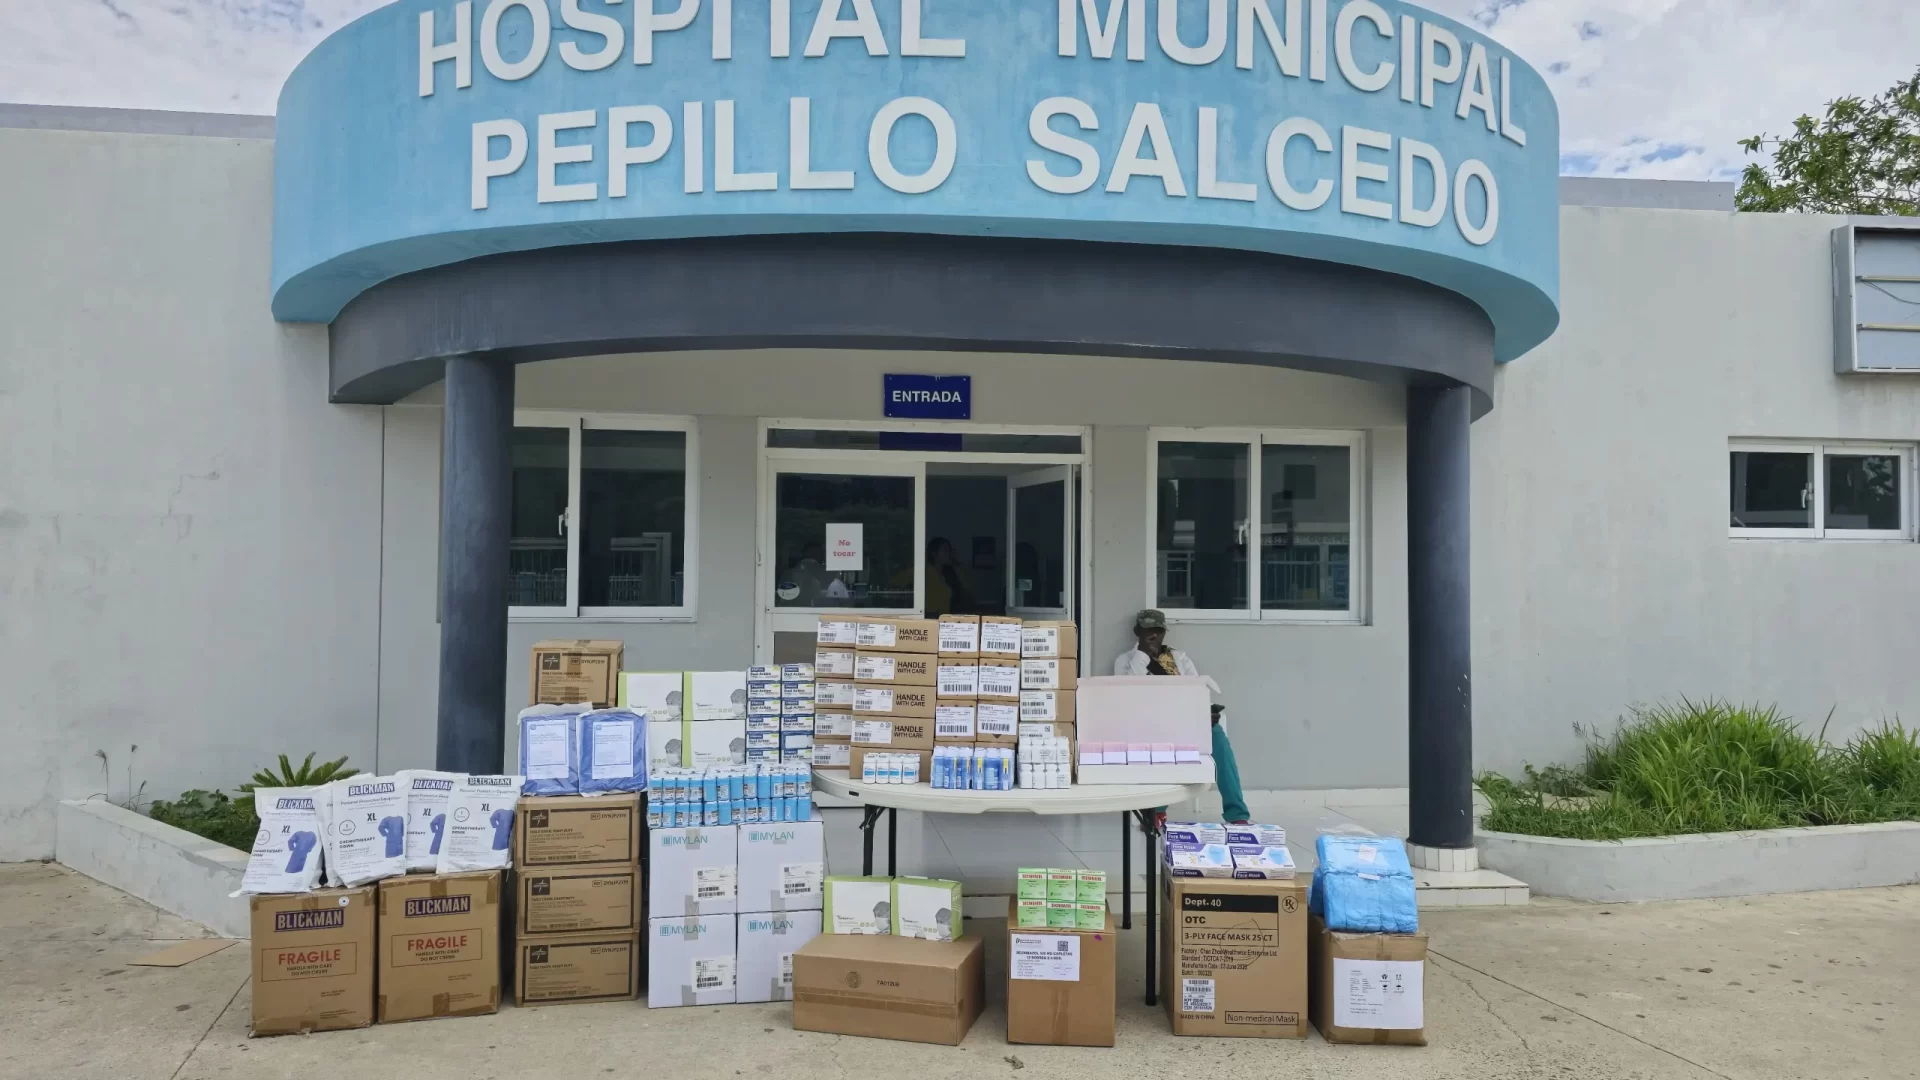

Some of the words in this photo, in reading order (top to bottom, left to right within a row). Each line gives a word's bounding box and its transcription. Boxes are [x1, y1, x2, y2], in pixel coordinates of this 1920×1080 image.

[1058, 0, 1526, 146] MUNICIPAL
[471, 96, 957, 210] PEPILLO
[1026, 96, 1499, 246] SALCEDO
[892, 391, 961, 402] ENTRADA
[895, 725, 924, 733] HANDLE
[350, 783, 394, 795] BLICKMAN
[423, 808, 432, 816] XL
[367, 813, 377, 821] XL
[282, 825, 291, 833] XL
[673, 836, 708, 845] MYLAN
[759, 832, 794, 840] MYLAN
[408, 898, 468, 915] BLICKMAN
[1185, 898, 1209, 906] Dept.
[1211, 899, 1222, 907] 40
[278, 911, 342, 929] BLICKMAN
[1185, 916, 1206, 924] OTC
[672, 925, 707, 934] MYLAN
[759, 921, 793, 930] MYLAN
[408, 936, 468, 951] FRAGILE
[279, 950, 341, 966] FRAGILE
[1228, 1014, 1275, 1023] Non-medical
[1277, 1015, 1296, 1023] Mask
